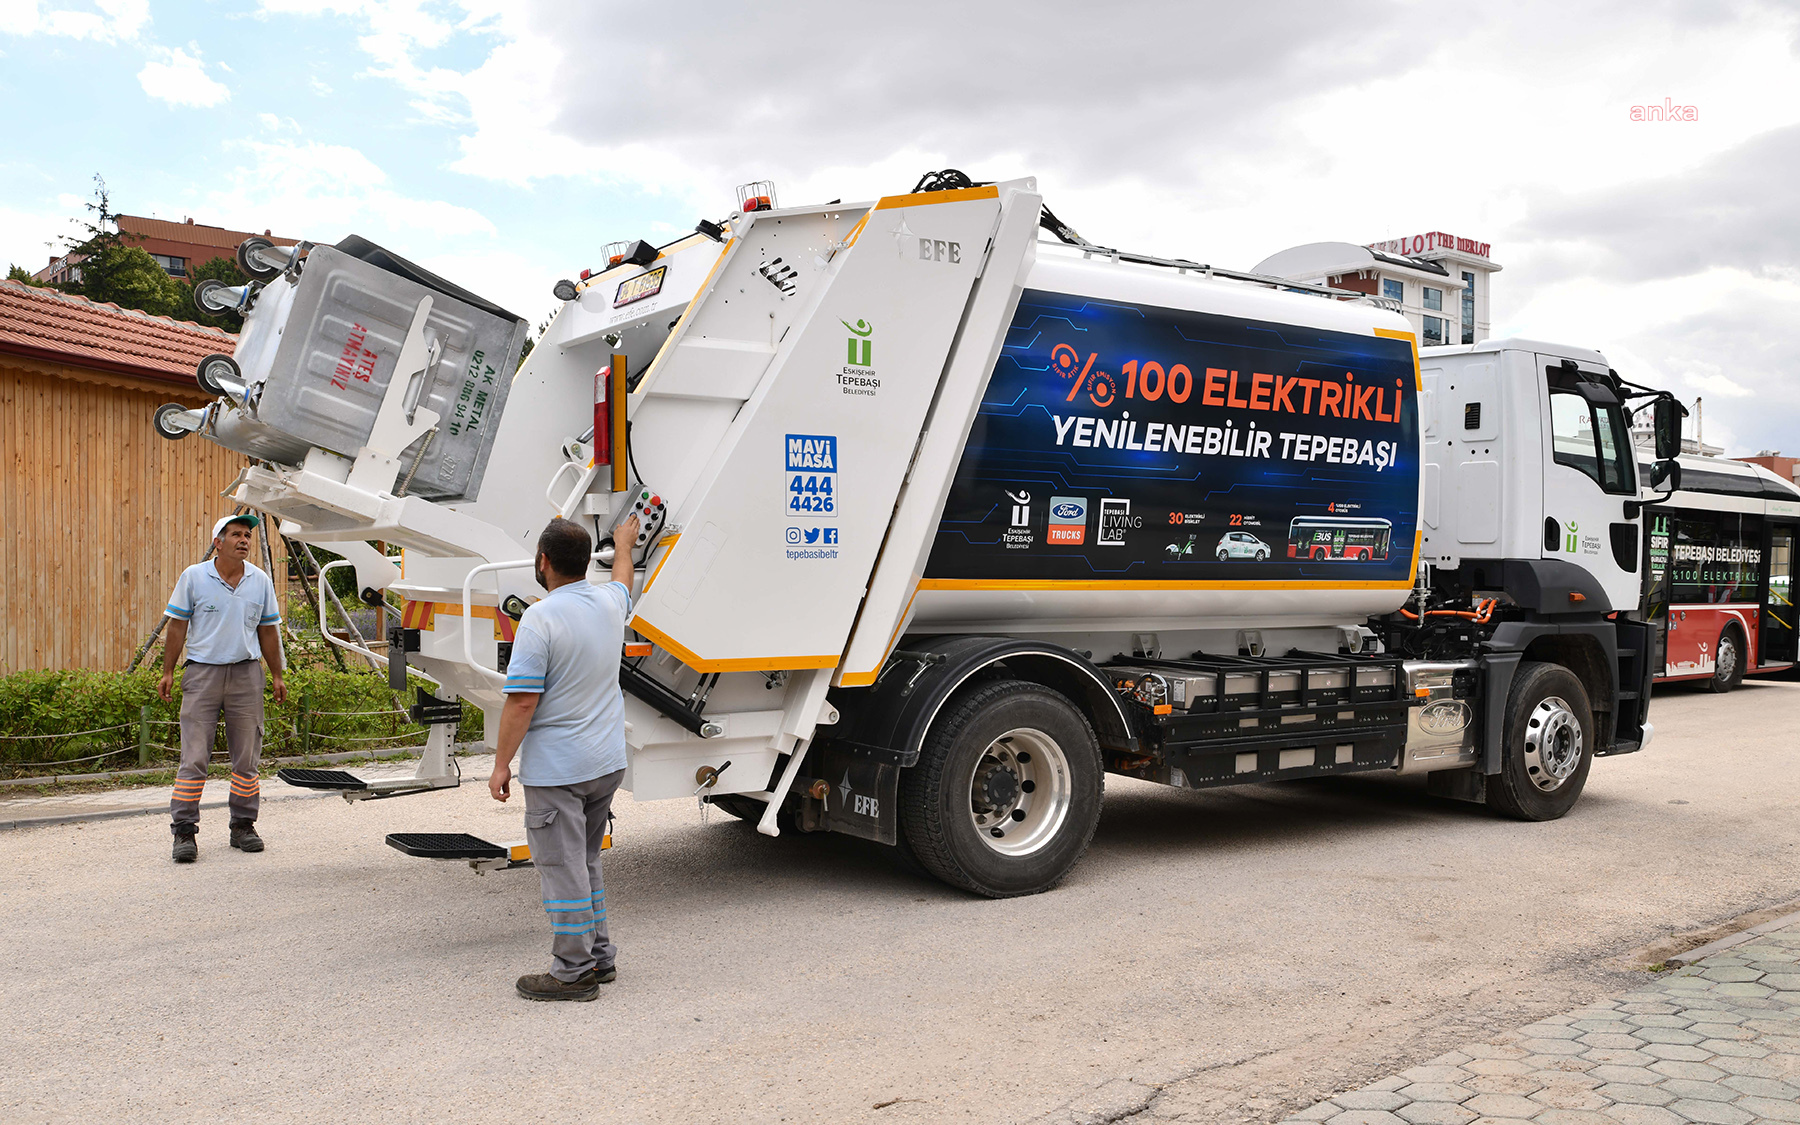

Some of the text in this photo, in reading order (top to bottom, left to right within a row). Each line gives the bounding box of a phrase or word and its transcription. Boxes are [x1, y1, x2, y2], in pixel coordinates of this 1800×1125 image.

[918, 237, 962, 264] EFE
[1437, 231, 1491, 258] THE MERLOT
[330, 322, 368, 391] ATMAYINIZ
[467, 350, 485, 379] 0212
[836, 374, 881, 389] TEPEBAŞI
[465, 364, 496, 432] AK METAL
[1121, 359, 1194, 404] 100
[1202, 371, 1403, 424] ELEKTRİKLİ
[454, 403, 468, 418] 94
[450, 421, 462, 436] 10
[1053, 410, 1398, 472] YENİLENEBİLİR TEPEBAŞI
[788, 453, 834, 469] MASA
[789, 475, 833, 496] 444
[789, 496, 834, 512] 4426
[1057, 504, 1079, 517] Ford
[1327, 502, 1336, 513] 4
[1103, 516, 1143, 528] LIVING
[1168, 512, 1184, 525] 30
[1229, 513, 1243, 526] 22
[1002, 533, 1034, 544] TEPEBAŞI
[1052, 530, 1081, 540] TRUCKS
[1650, 536, 1669, 549] SIFIR
[786, 549, 838, 561] tepebasibeltr
[1674, 545, 1715, 564] TEPEBAŞI
[1672, 570, 1698, 580] %100
[1429, 705, 1463, 728] Ford
[853, 794, 880, 818] EFE
